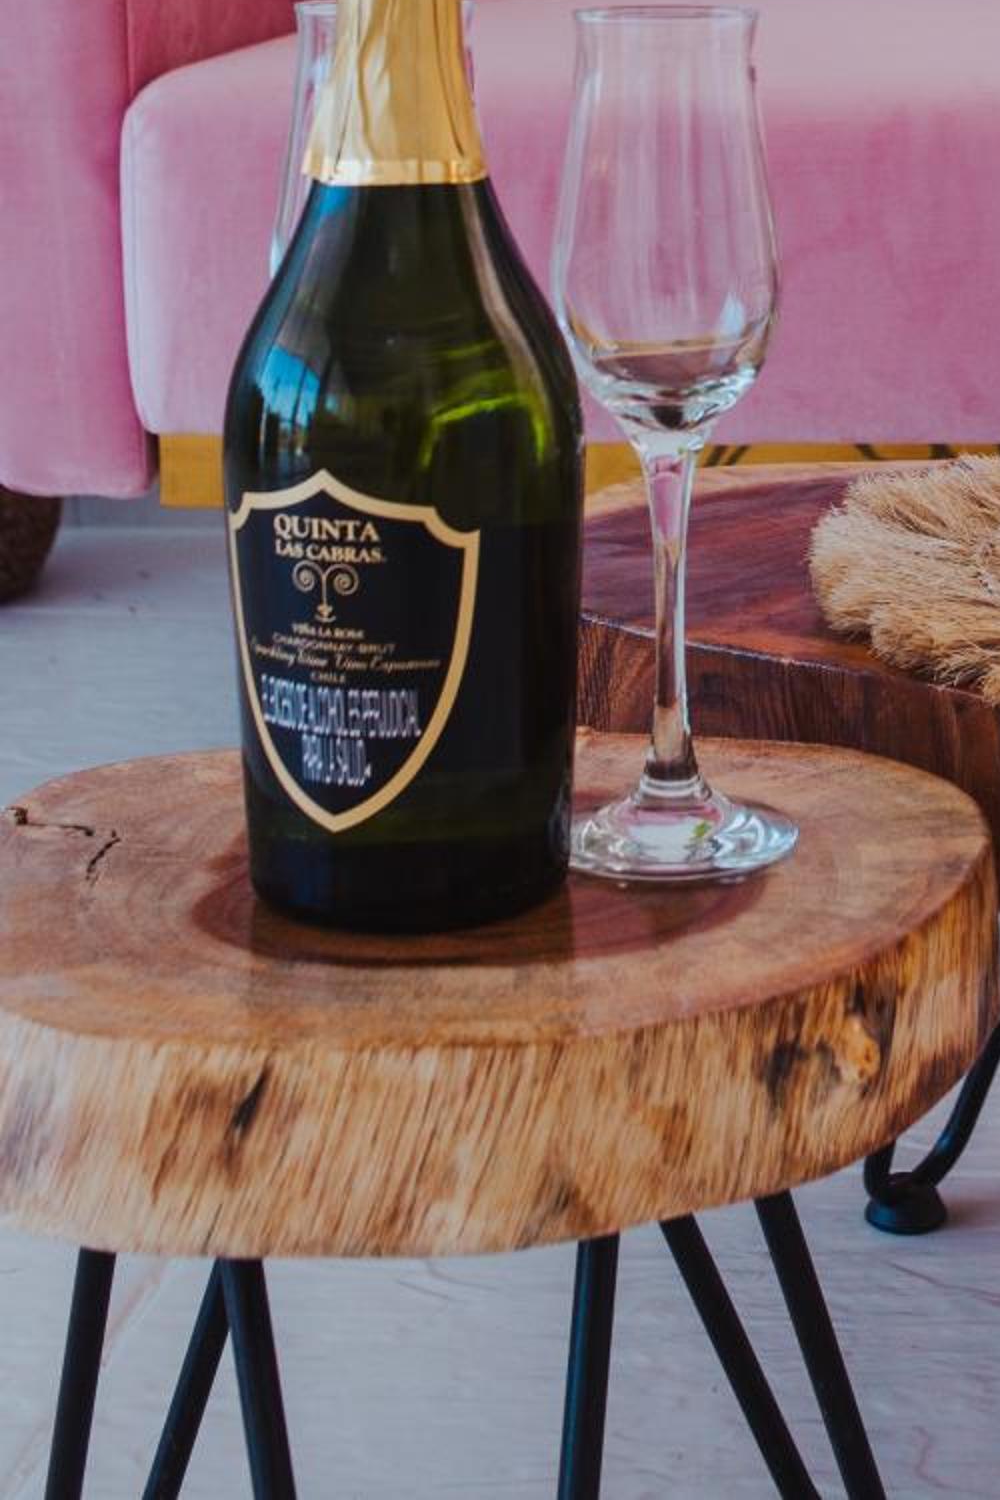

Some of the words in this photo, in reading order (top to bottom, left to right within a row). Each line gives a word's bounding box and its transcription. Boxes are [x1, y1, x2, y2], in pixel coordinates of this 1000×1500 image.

[273, 513, 380, 542] QUINTA
[275, 538, 305, 558] LAS
[306, 544, 382, 563] CABRAS
